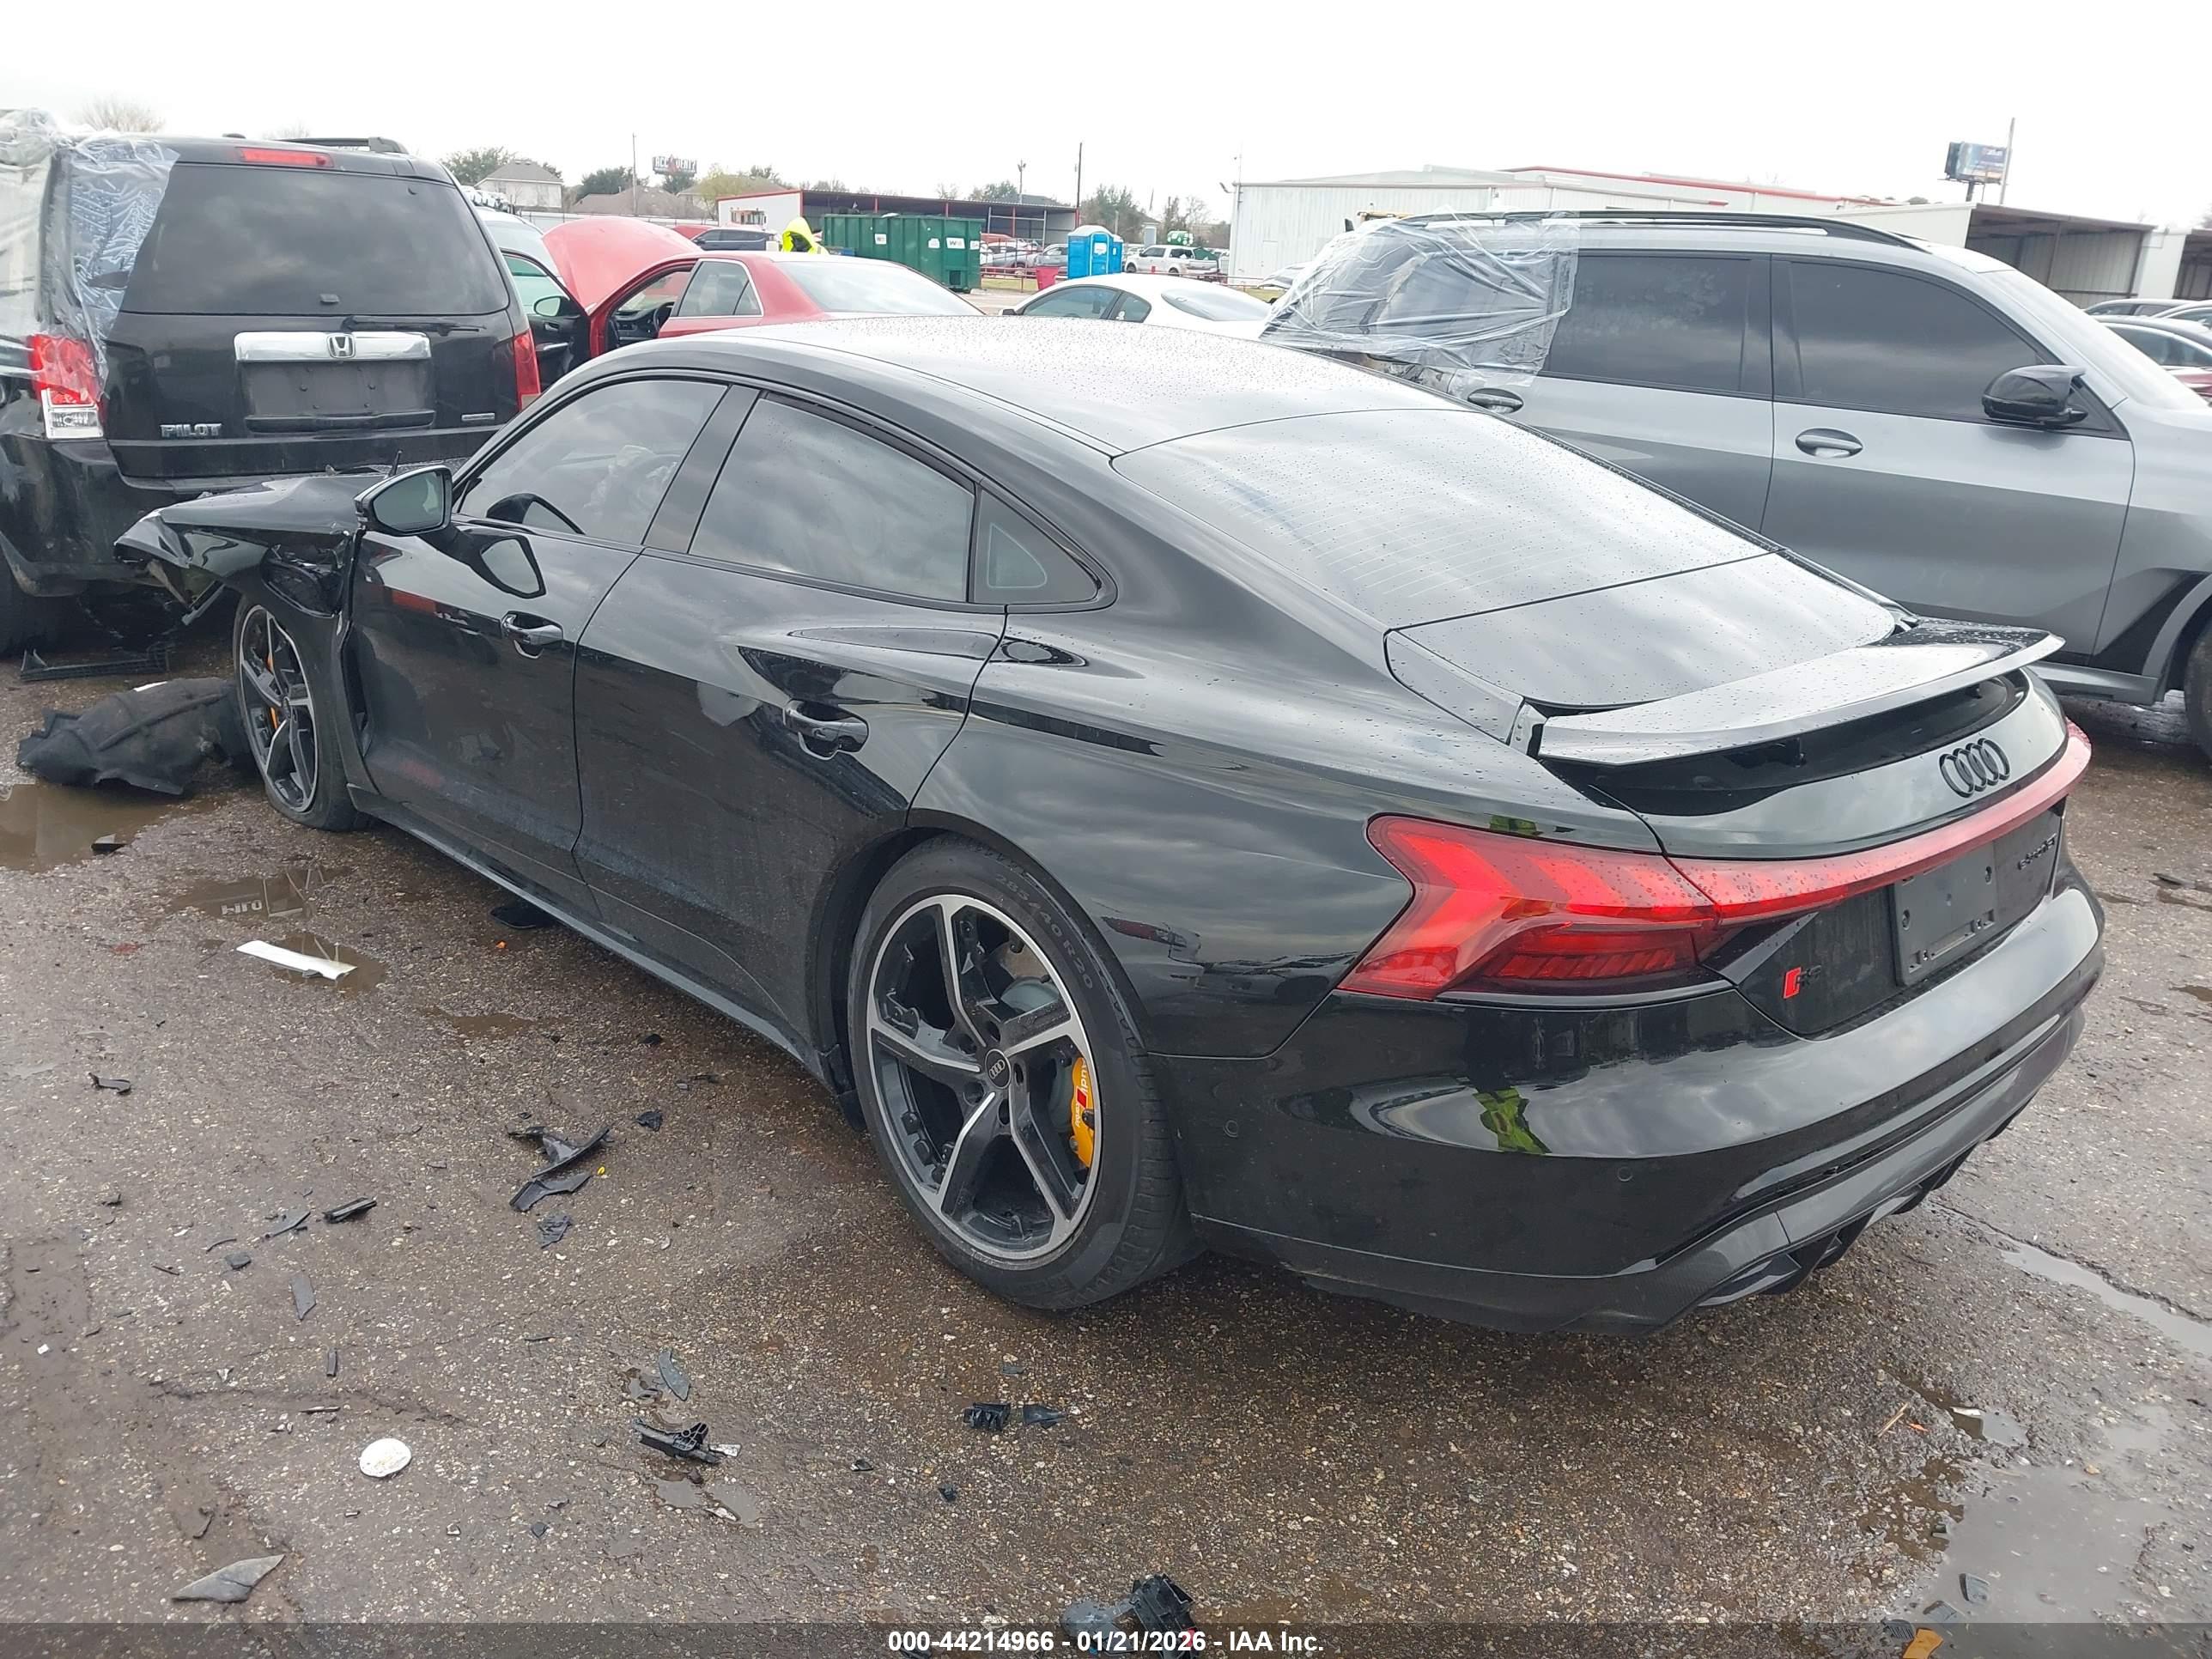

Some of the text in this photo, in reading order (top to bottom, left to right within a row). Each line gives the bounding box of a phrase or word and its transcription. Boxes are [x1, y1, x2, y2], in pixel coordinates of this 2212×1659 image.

[160, 422, 222, 437] PILOT
[996, 873, 1063, 937] 285/40
[1079, 1060, 1089, 1093] Audi
